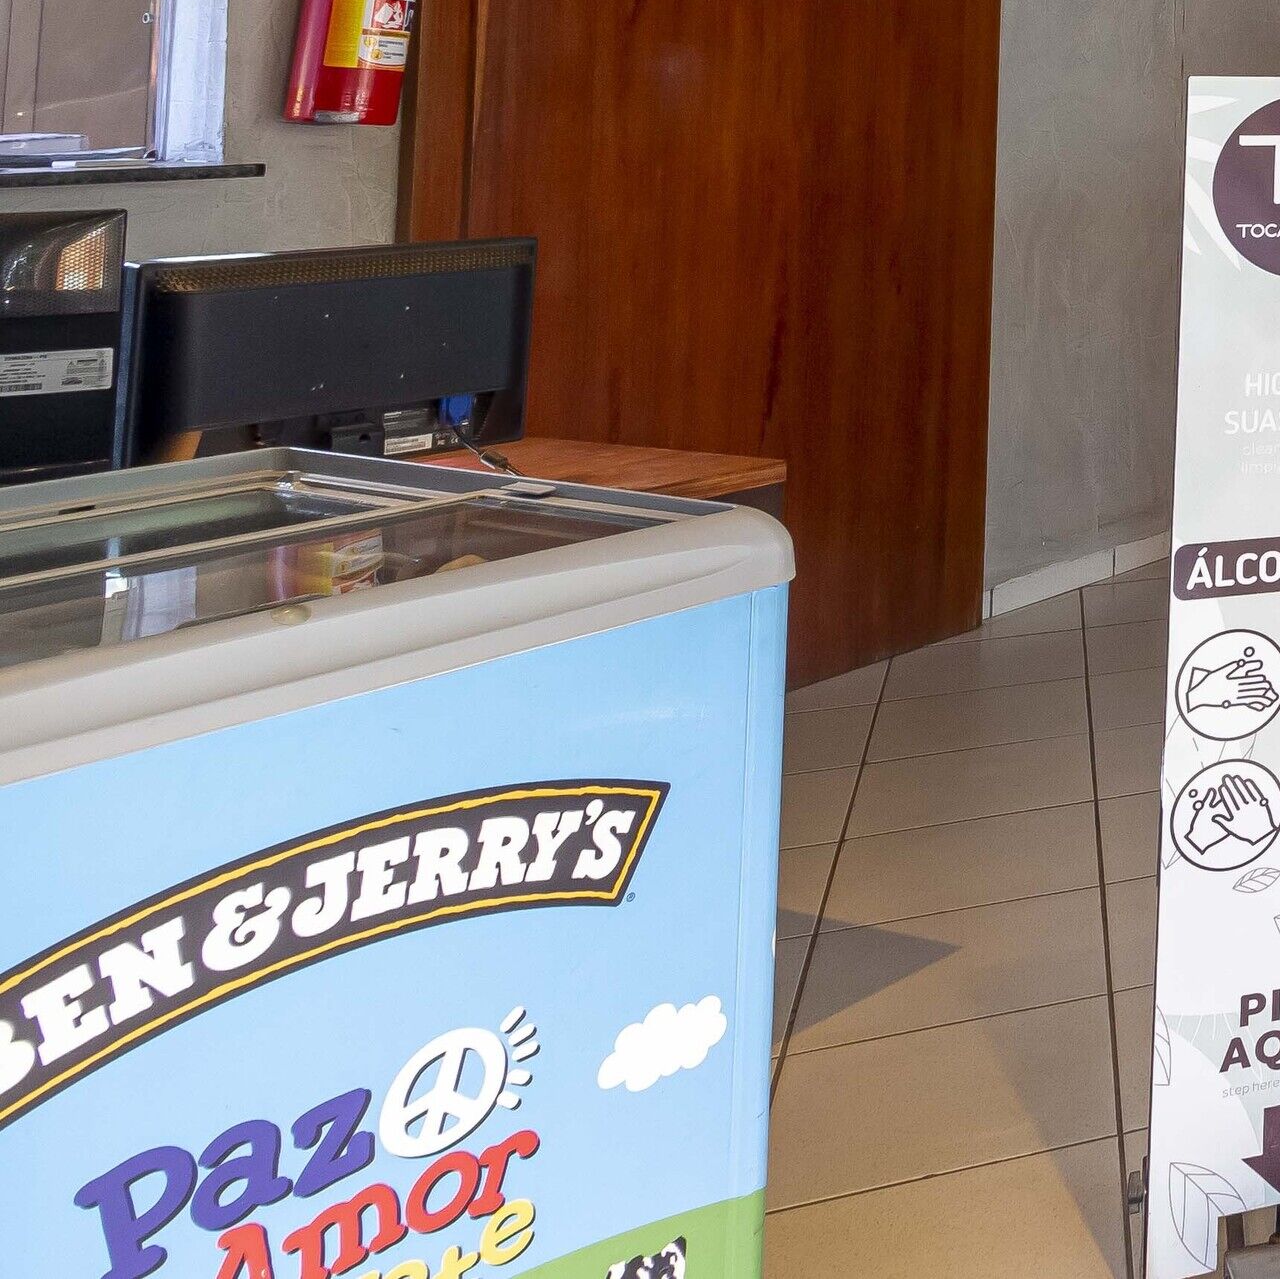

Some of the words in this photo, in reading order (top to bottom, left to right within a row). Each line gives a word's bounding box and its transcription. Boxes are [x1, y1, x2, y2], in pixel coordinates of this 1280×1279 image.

[201, 881, 292, 972] &
[291, 798, 636, 938] JERRY'S
[1222, 1085, 1250, 1098] step
[1252, 1079, 1280, 1092] here
[73, 1087, 376, 1279] Paz
